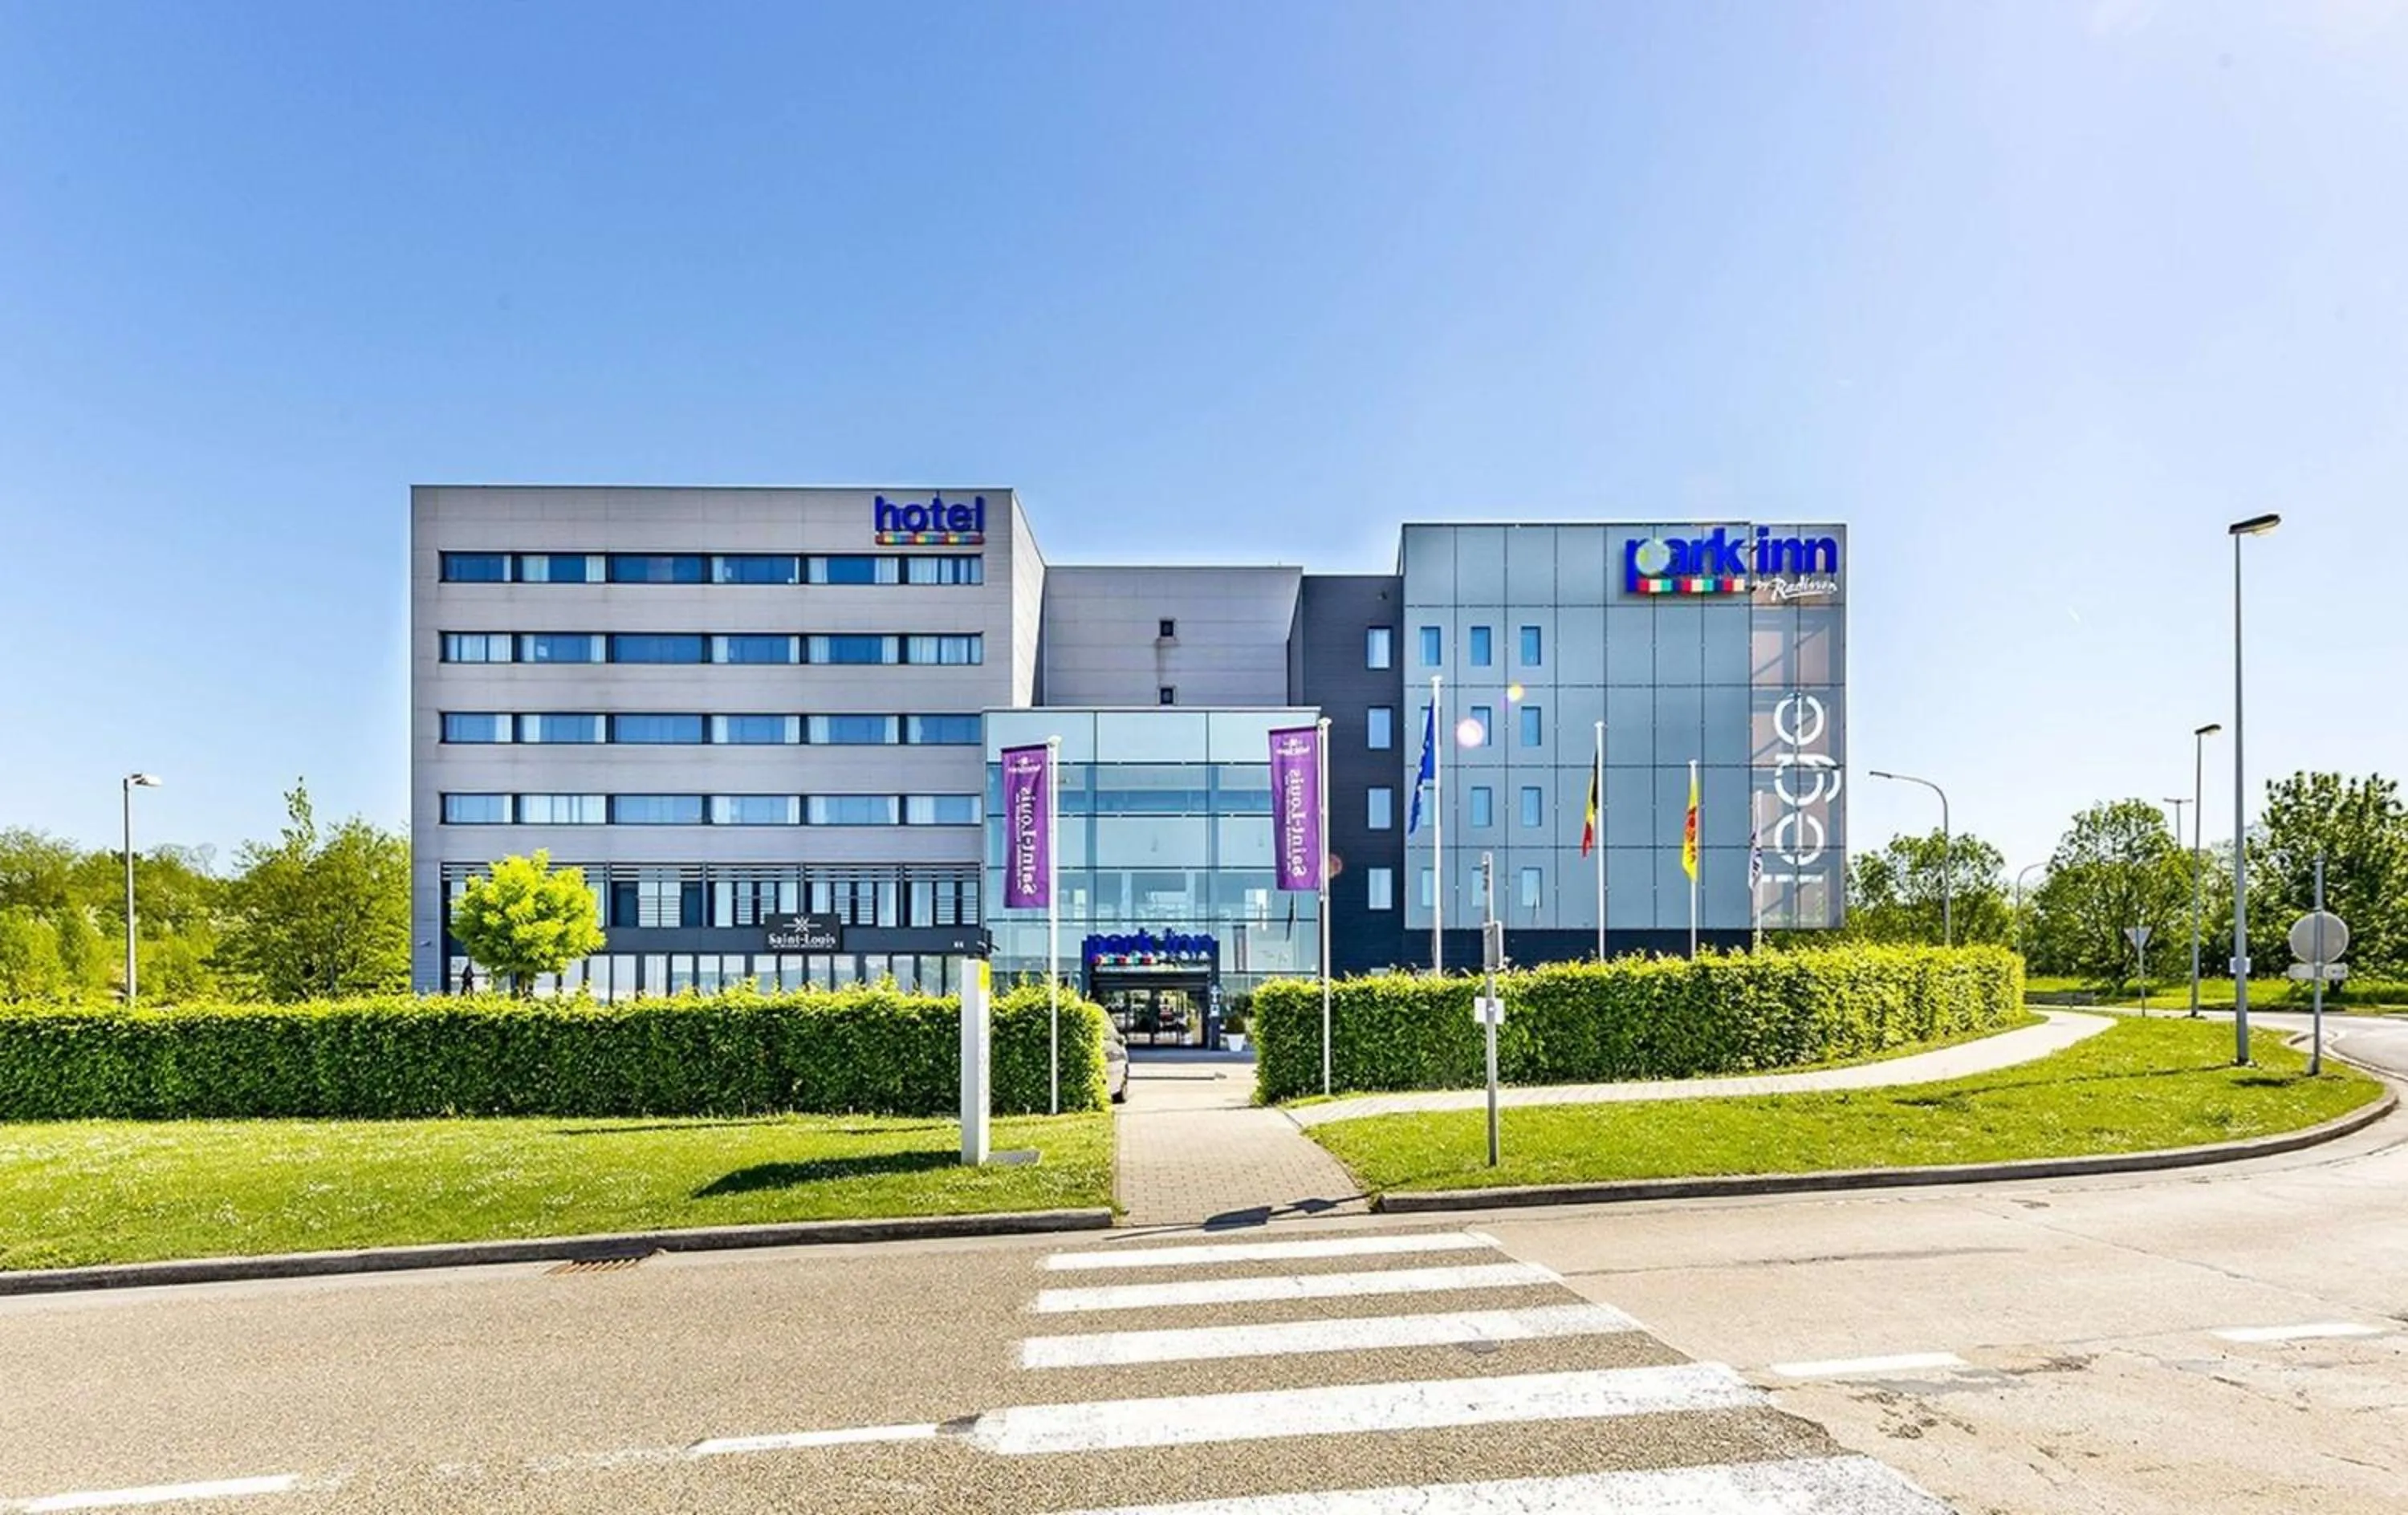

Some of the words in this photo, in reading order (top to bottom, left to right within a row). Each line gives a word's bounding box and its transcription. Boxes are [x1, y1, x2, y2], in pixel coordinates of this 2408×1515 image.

[875, 494, 985, 532] hotel
[1625, 526, 1748, 592] park
[1756, 525, 1838, 575] inn
[768, 932, 836, 944] Saint-Louis
[1164, 928, 1214, 956] inn
